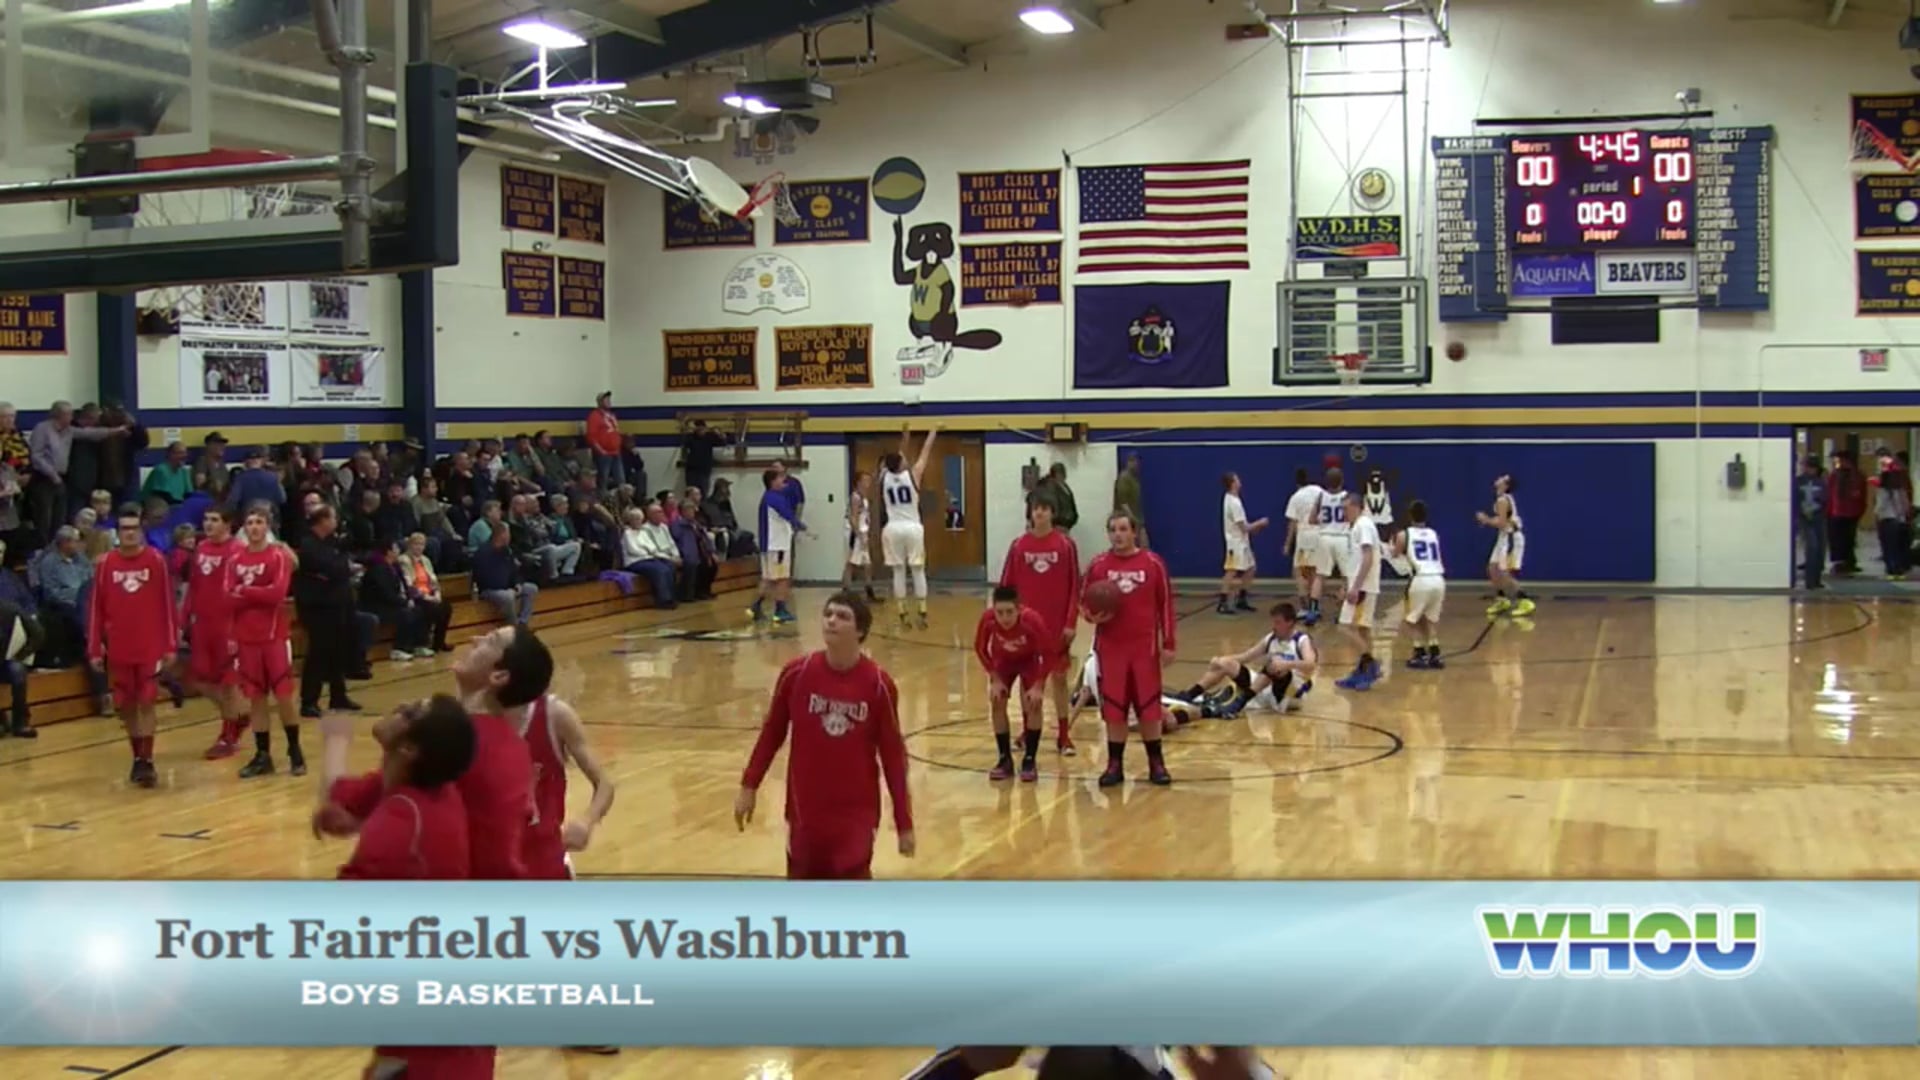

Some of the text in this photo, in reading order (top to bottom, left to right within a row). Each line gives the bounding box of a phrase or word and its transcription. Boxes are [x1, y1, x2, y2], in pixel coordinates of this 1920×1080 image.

[1710, 129, 1746, 140] GUESTS
[1579, 132, 1640, 162] 4:45
[1651, 135, 1689, 149] Guests
[1517, 156, 1554, 186] 00
[1654, 153, 1691, 182] 00
[1004, 175, 1035, 187] CLASS
[1583, 181, 1619, 194] period
[1633, 176, 1641, 195] 1
[980, 188, 1039, 202] BASKETBALL
[971, 202, 1050, 216] EASTERN MAINE
[1526, 203, 1542, 225] 0
[1577, 202, 1626, 224] 00-0
[1667, 200, 1682, 222] 0
[1298, 218, 1399, 235] W.D.H.S.
[1584, 228, 1619, 242] player
[1660, 228, 1687, 240] fouls
[1005, 246, 1036, 258] CLASS
[981, 260, 1040, 273] BASKETBALL
[1607, 262, 1686, 282] BEAVERS
[1023, 273, 1058, 286] LEAGUE
[914, 284, 929, 306] W
[28, 310, 56, 328] MAINE
[668, 334, 725, 345] WASHBURN
[780, 329, 837, 340] WASHBURN
[672, 345, 750, 358] BOYS CLASS D
[781, 338, 865, 351] BOYS CLASS D
[831, 350, 846, 361] 90
[719, 360, 733, 371] 90
[781, 363, 866, 377] EASTERN MAINE
[670, 374, 752, 386] STATE CHAMPS
[801, 373, 846, 385] CHAMPS
[887, 486, 912, 505] 10
[1321, 505, 1345, 524] 30
[1412, 540, 1439, 561] 21
